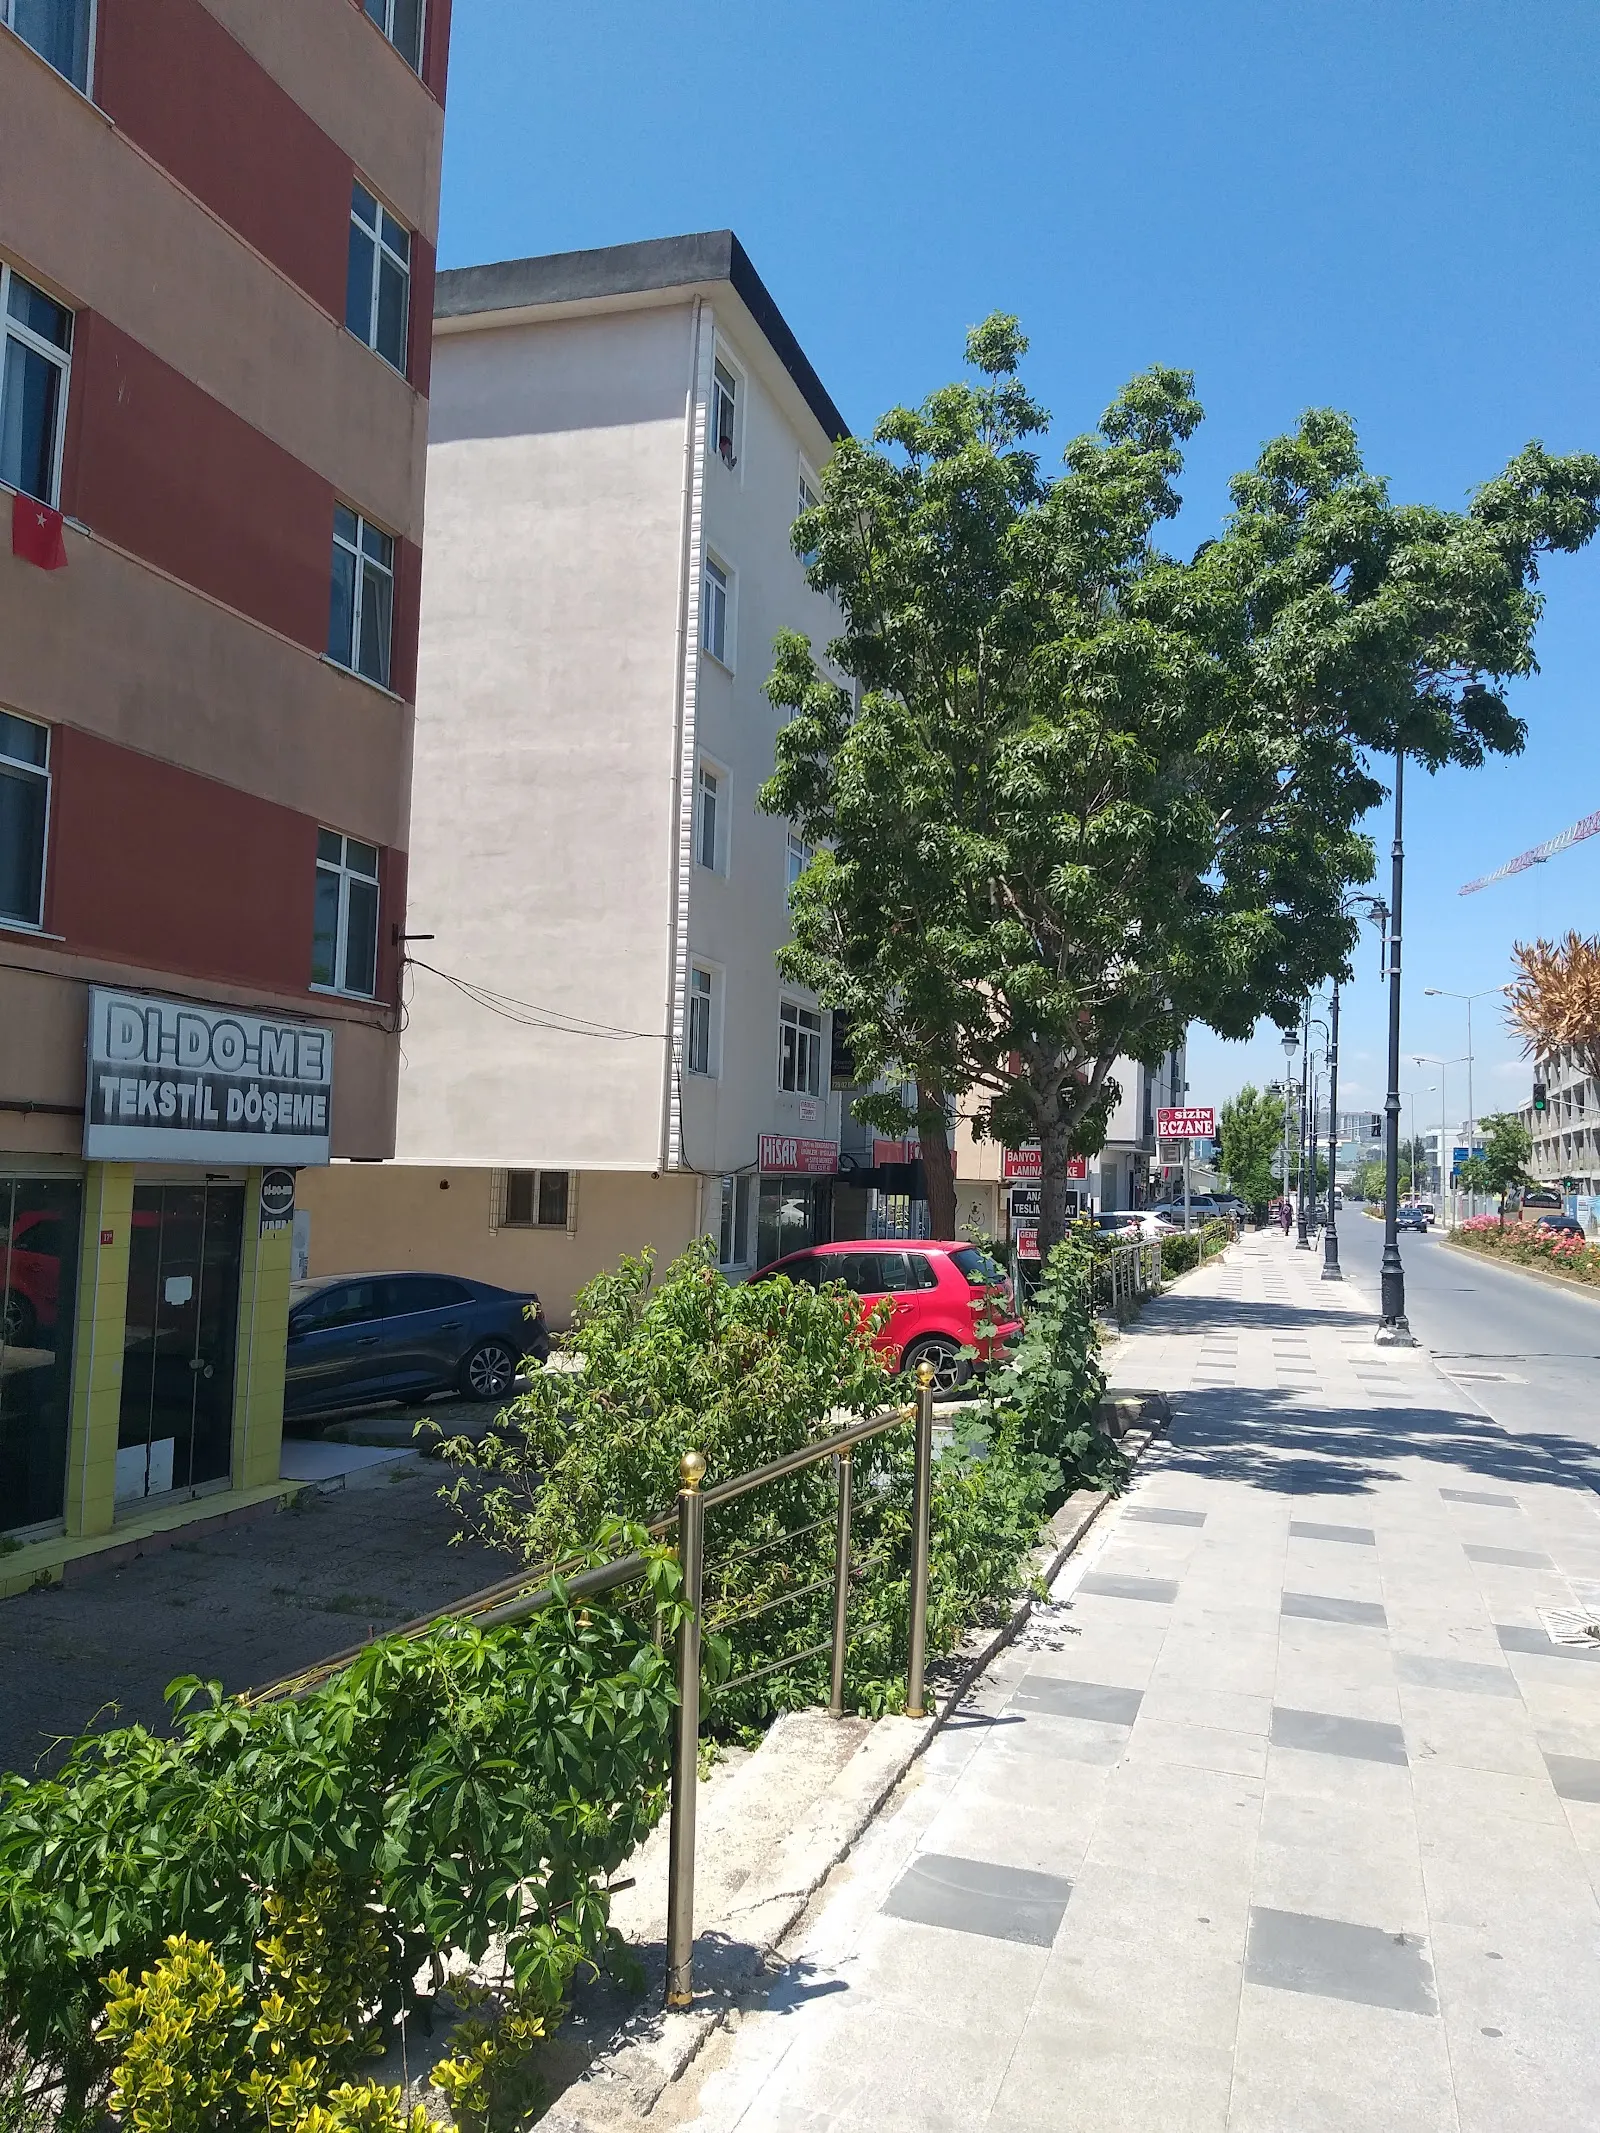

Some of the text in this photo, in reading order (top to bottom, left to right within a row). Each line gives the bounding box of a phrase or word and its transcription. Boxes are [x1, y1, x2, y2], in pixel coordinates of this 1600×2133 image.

[100, 1076, 326, 1132] TEKSTİL DÖŞEME
[1174, 1109, 1211, 1119] SİZİN
[1160, 1120, 1213, 1135] ECZANE
[1008, 1152, 1036, 1163] BANYO
[1012, 1163, 1042, 1176] LAMİNA
[1026, 1191, 1042, 1201] ANA
[1020, 1231, 1038, 1239] GENE
[1025, 1240, 1037, 1248] SIH
